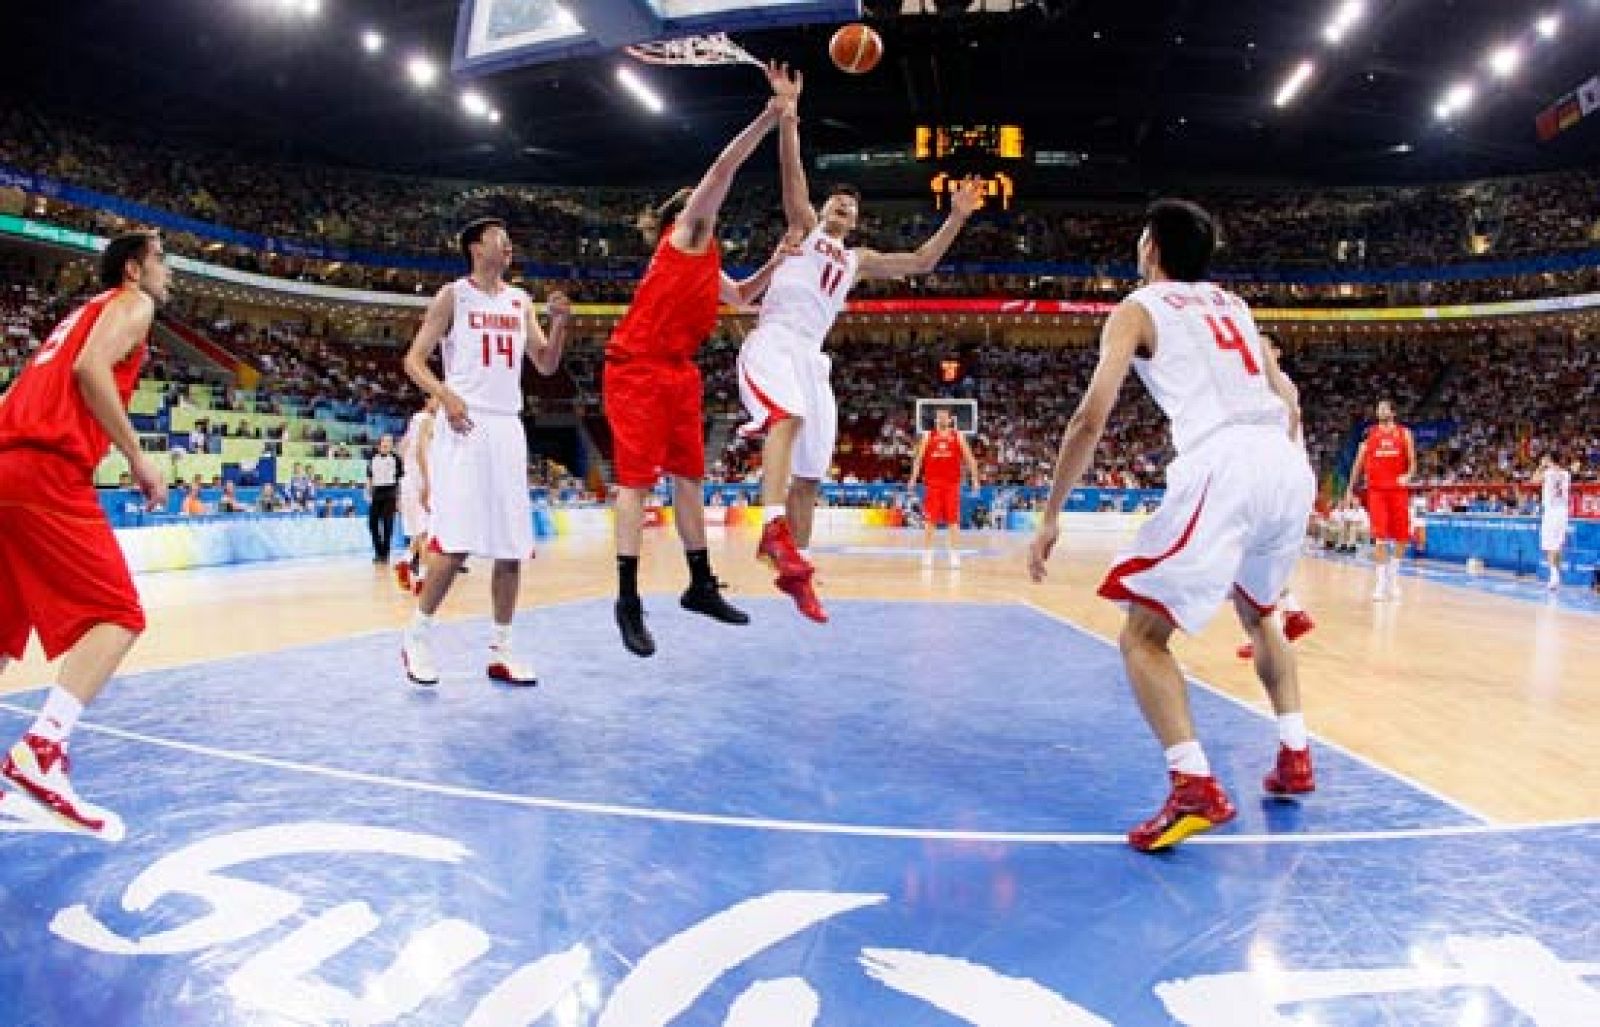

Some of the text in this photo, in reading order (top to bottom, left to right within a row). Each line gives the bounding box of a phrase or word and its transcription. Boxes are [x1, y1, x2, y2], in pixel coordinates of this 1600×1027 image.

[820, 262, 844, 297] 11
[468, 312, 521, 331] CHINA
[481, 333, 513, 368] 14
[1203, 314, 1260, 375] 4
